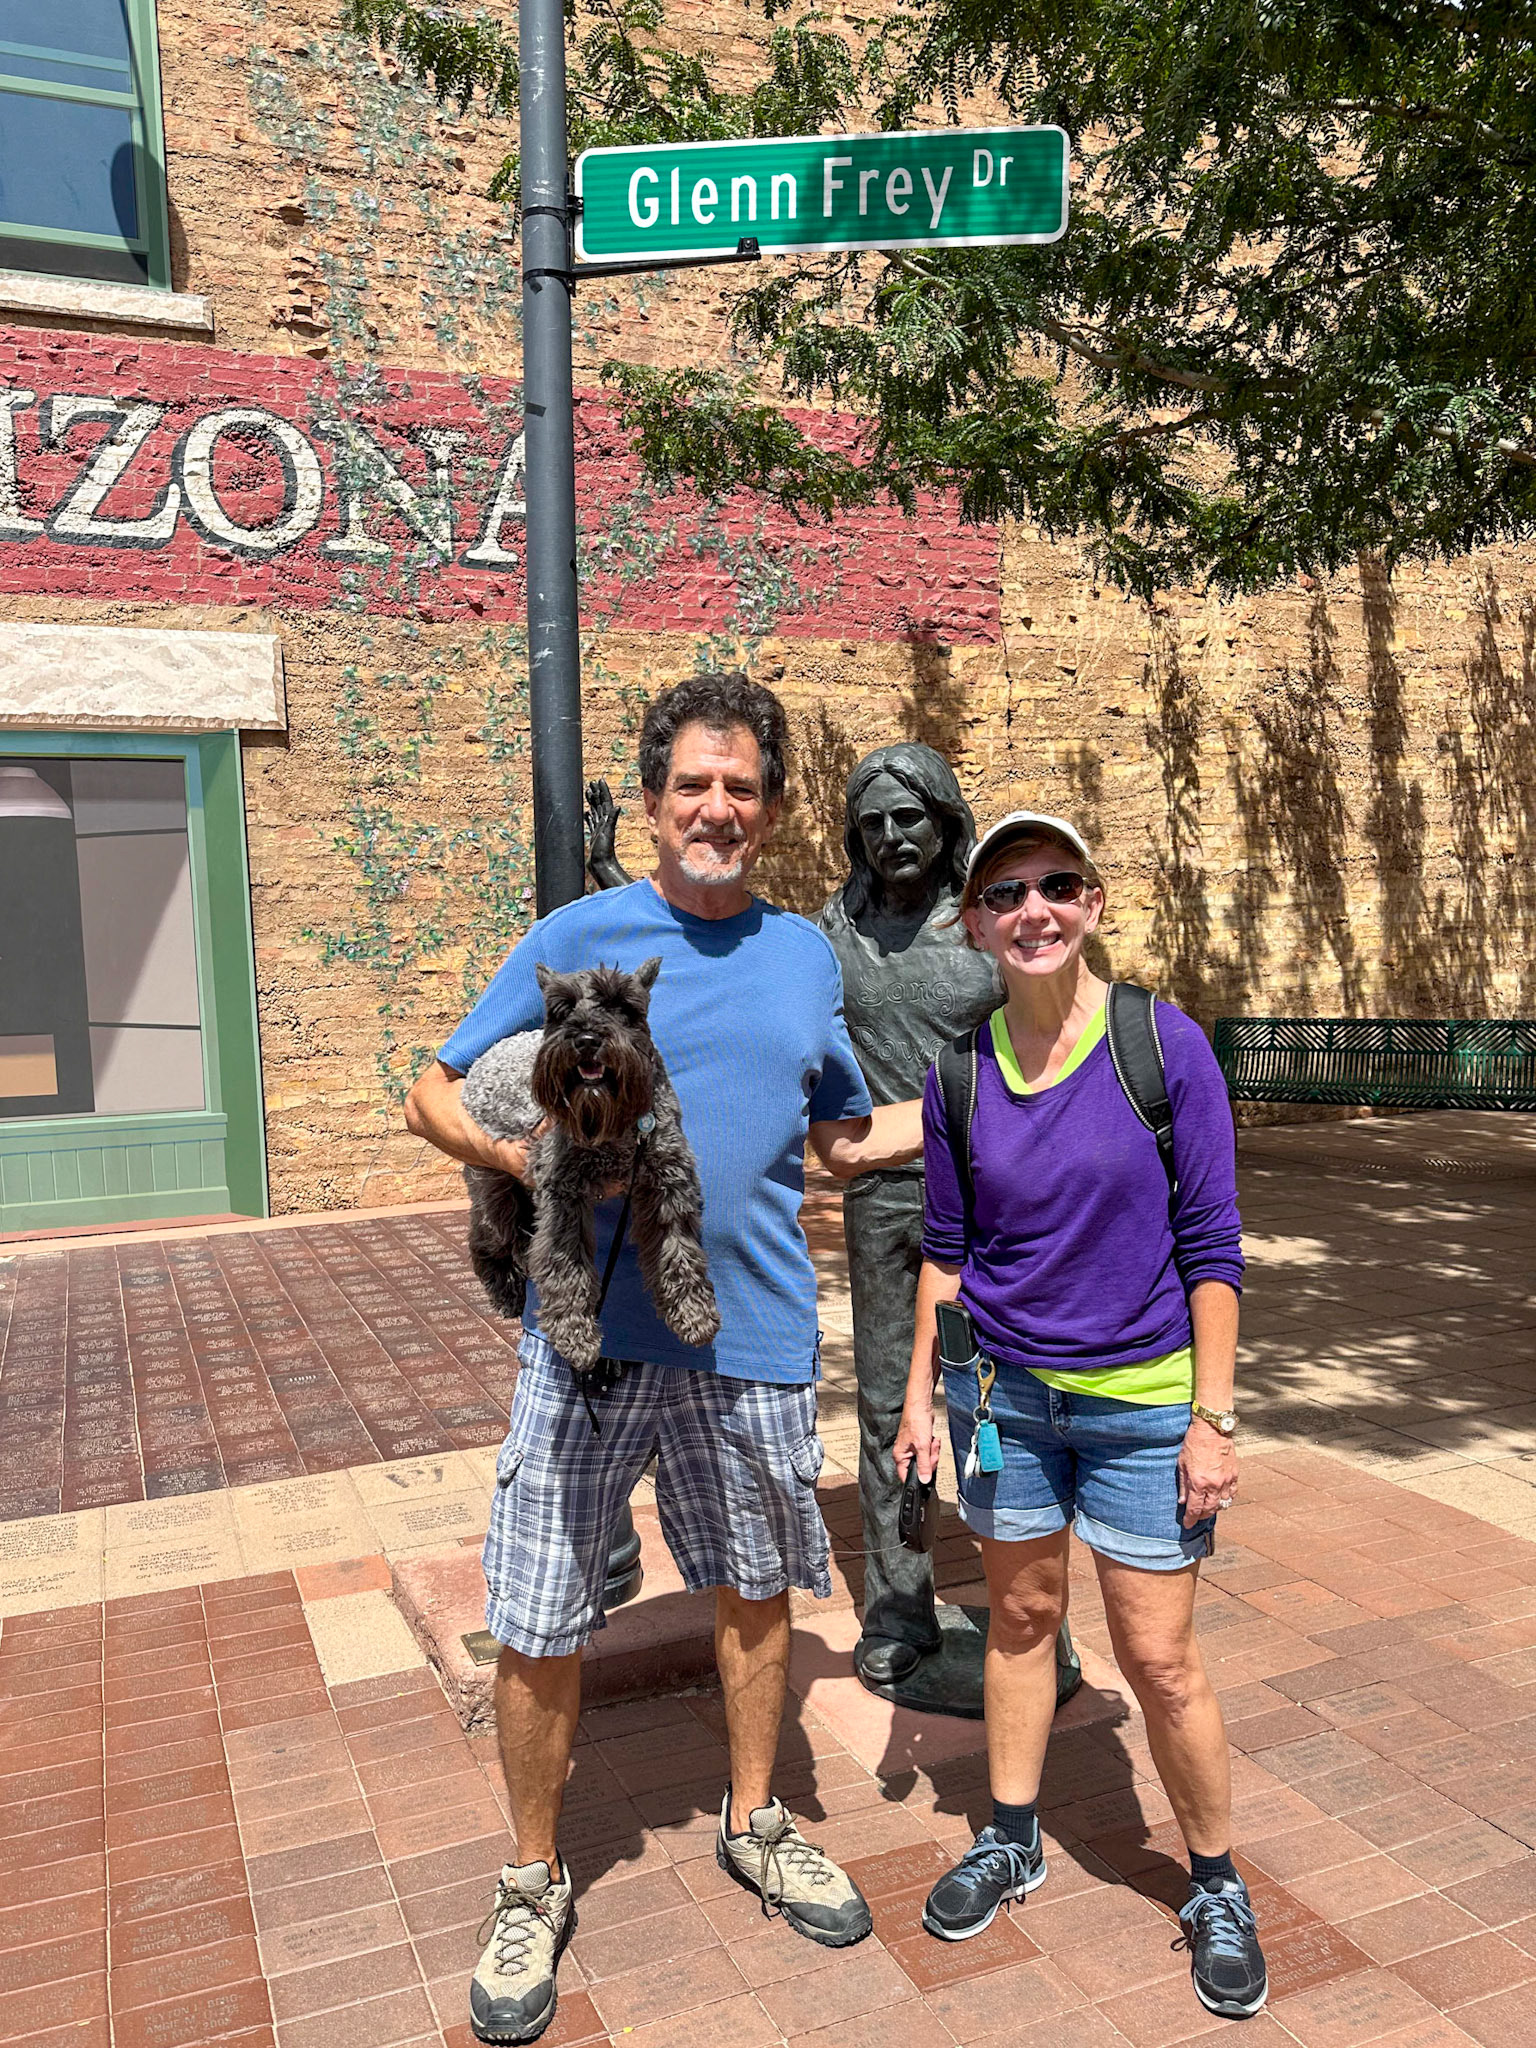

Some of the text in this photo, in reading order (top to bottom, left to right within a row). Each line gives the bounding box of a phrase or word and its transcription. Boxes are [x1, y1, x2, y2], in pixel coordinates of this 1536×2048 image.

[627, 148, 1014, 230] Glenn Frey Dr
[857, 963, 957, 1017] Song
[2, 1590, 29, 1598] MOM
[41, 1584, 63, 1592] DAD
